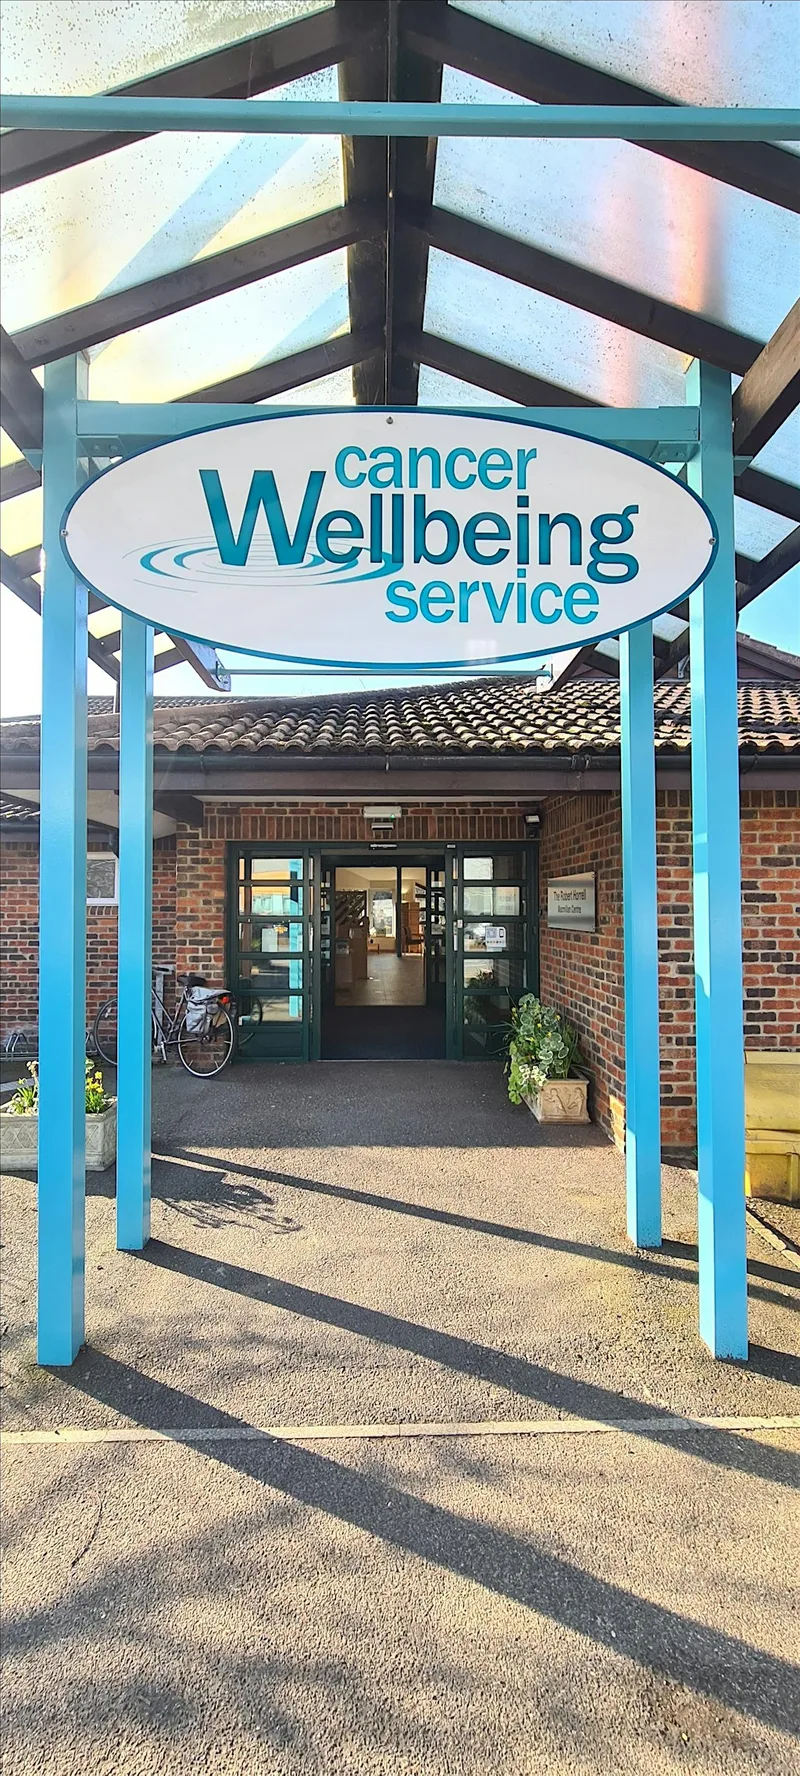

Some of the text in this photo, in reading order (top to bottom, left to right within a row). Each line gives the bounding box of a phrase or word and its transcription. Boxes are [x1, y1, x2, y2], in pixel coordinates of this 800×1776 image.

[334, 444, 537, 490] cancer
[199, 468, 640, 583] Wellbeing
[384, 568, 600, 625] service
